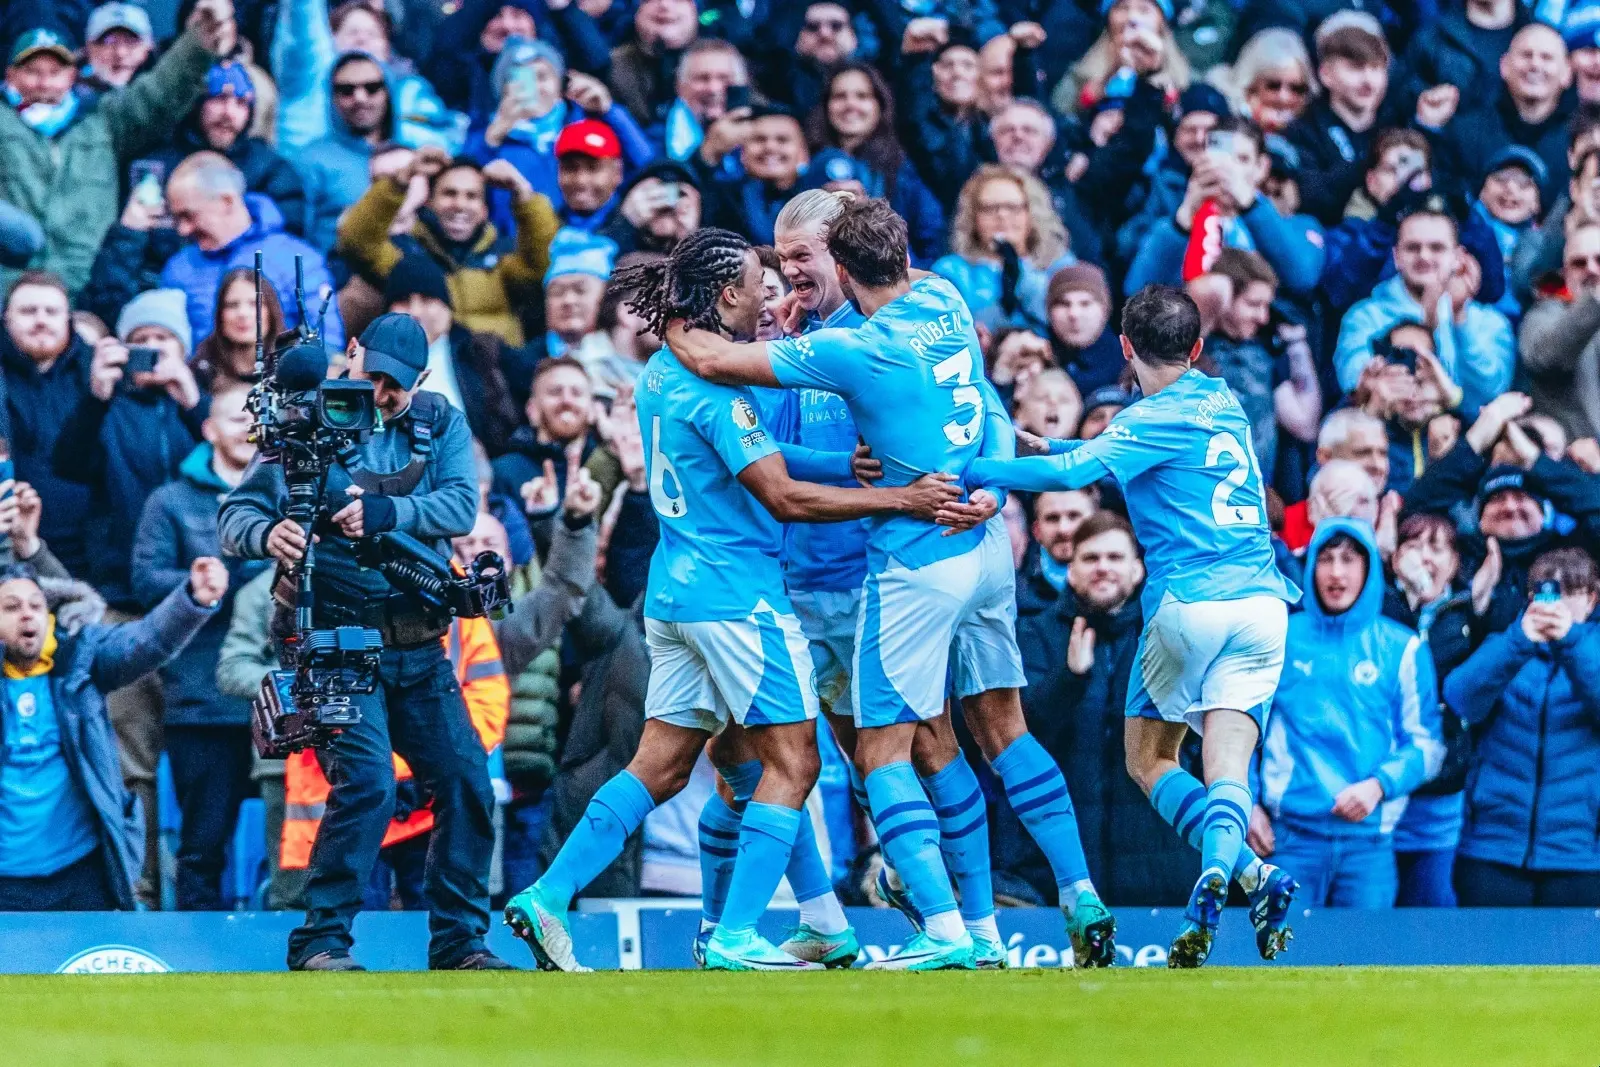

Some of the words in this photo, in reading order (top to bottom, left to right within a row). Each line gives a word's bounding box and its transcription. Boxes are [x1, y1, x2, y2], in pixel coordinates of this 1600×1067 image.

[909, 311, 963, 357] RÚBEN
[931, 346, 984, 447] 3
[649, 415, 688, 518] 6
